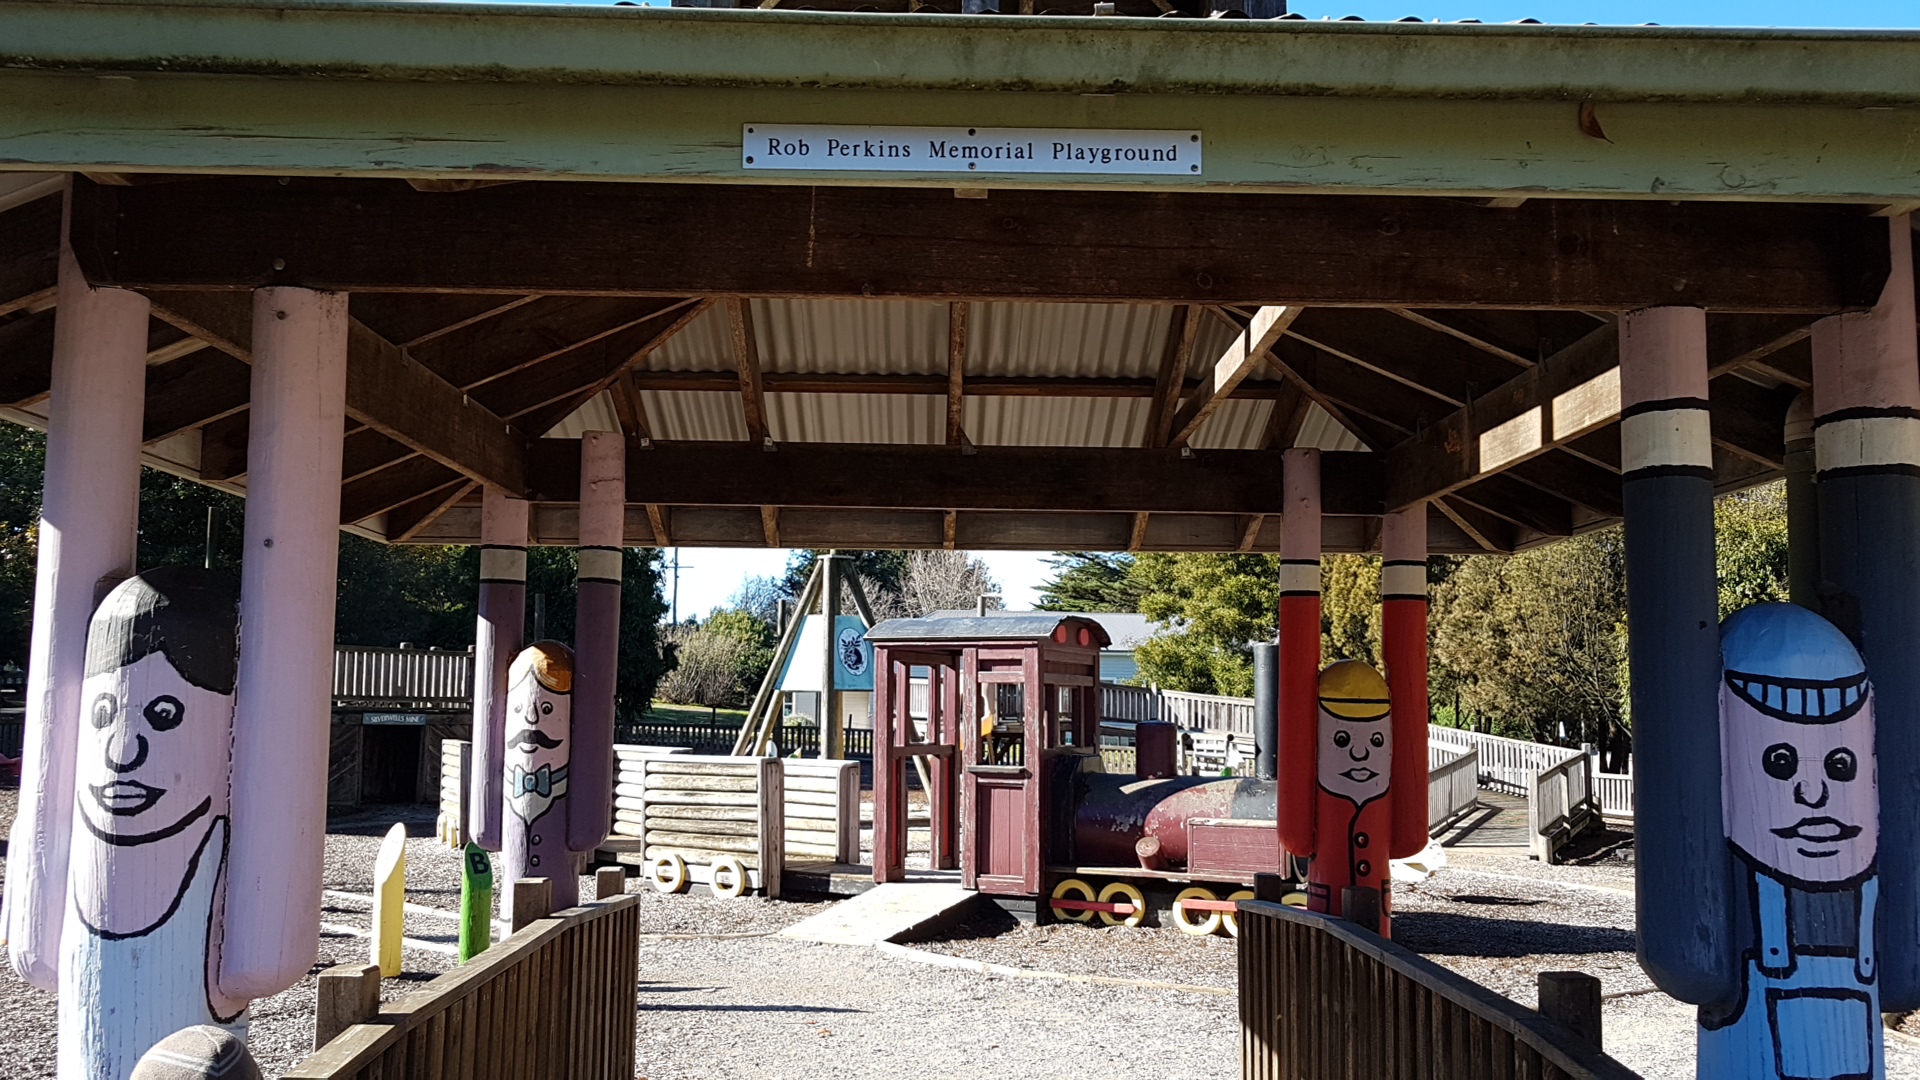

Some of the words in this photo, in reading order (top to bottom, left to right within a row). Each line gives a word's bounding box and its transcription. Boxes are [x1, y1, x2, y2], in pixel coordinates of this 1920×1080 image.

[767, 137, 810, 156] Rob
[826, 139, 912, 158] Perkins
[928, 140, 1034, 160] Memorial
[1051, 142, 1178, 164] Playground
[406, 715, 420, 723] MINE
[469, 852, 489, 875] B
